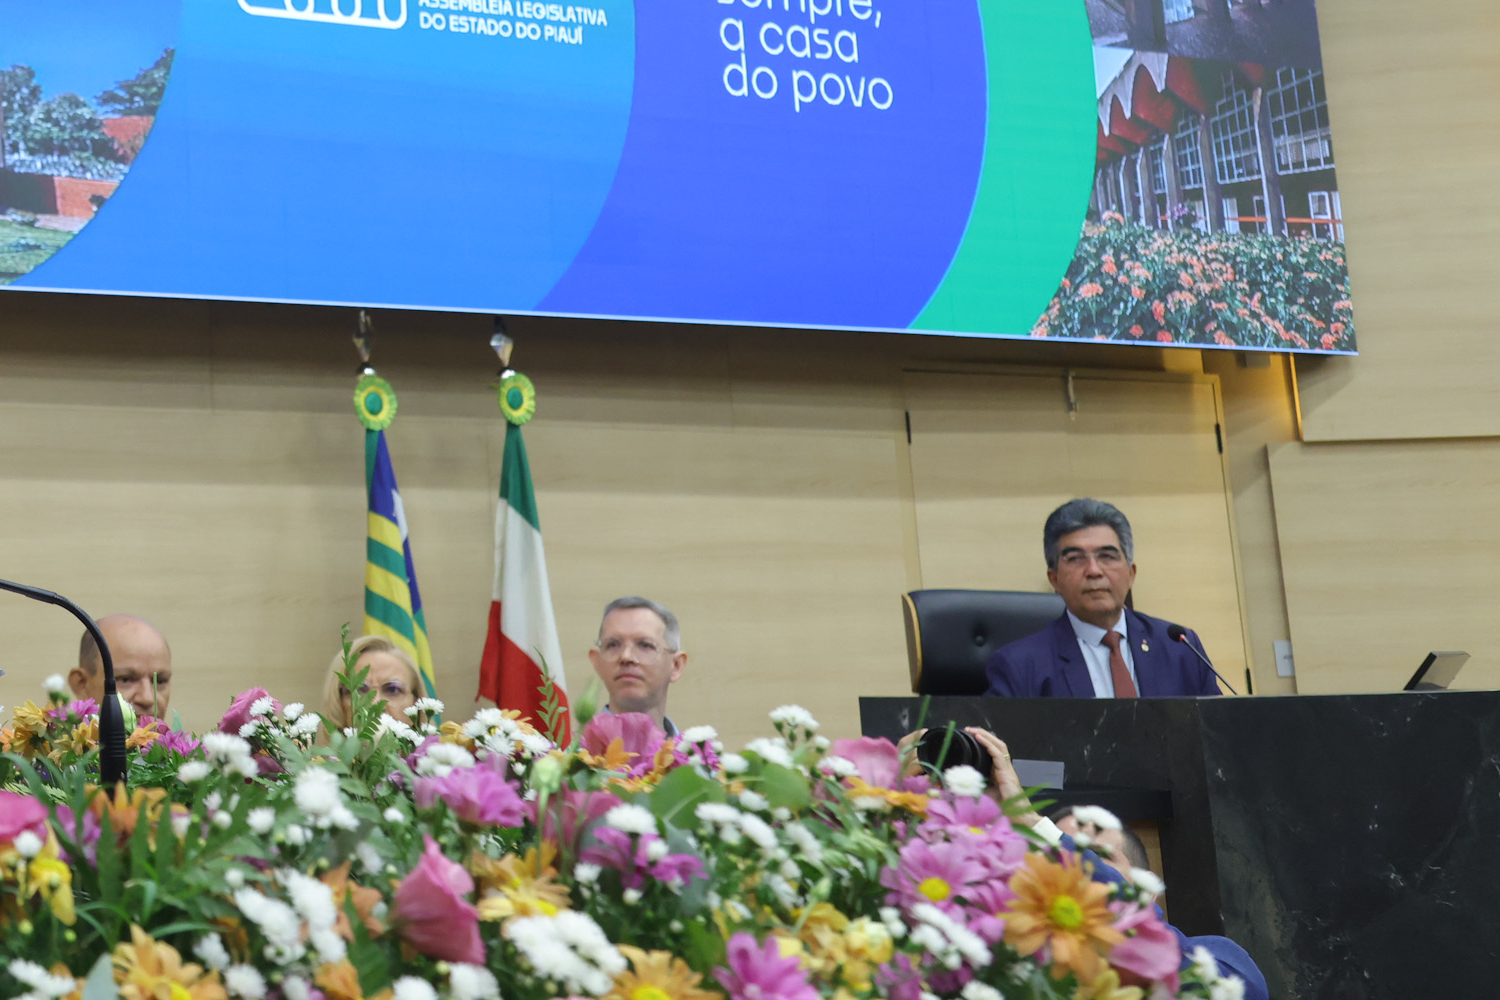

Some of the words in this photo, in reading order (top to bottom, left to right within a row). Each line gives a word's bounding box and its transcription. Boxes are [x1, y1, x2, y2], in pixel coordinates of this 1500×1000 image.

[419, 11, 446, 31] DO
[449, 14, 513, 38] ESTADO
[515, 21, 542, 41] DO
[516, 0, 608, 26] LEGISLATIVA
[719, 17, 745, 52] a
[759, 22, 859, 64] casa
[723, 52, 778, 99] do
[792, 69, 894, 113] povo
